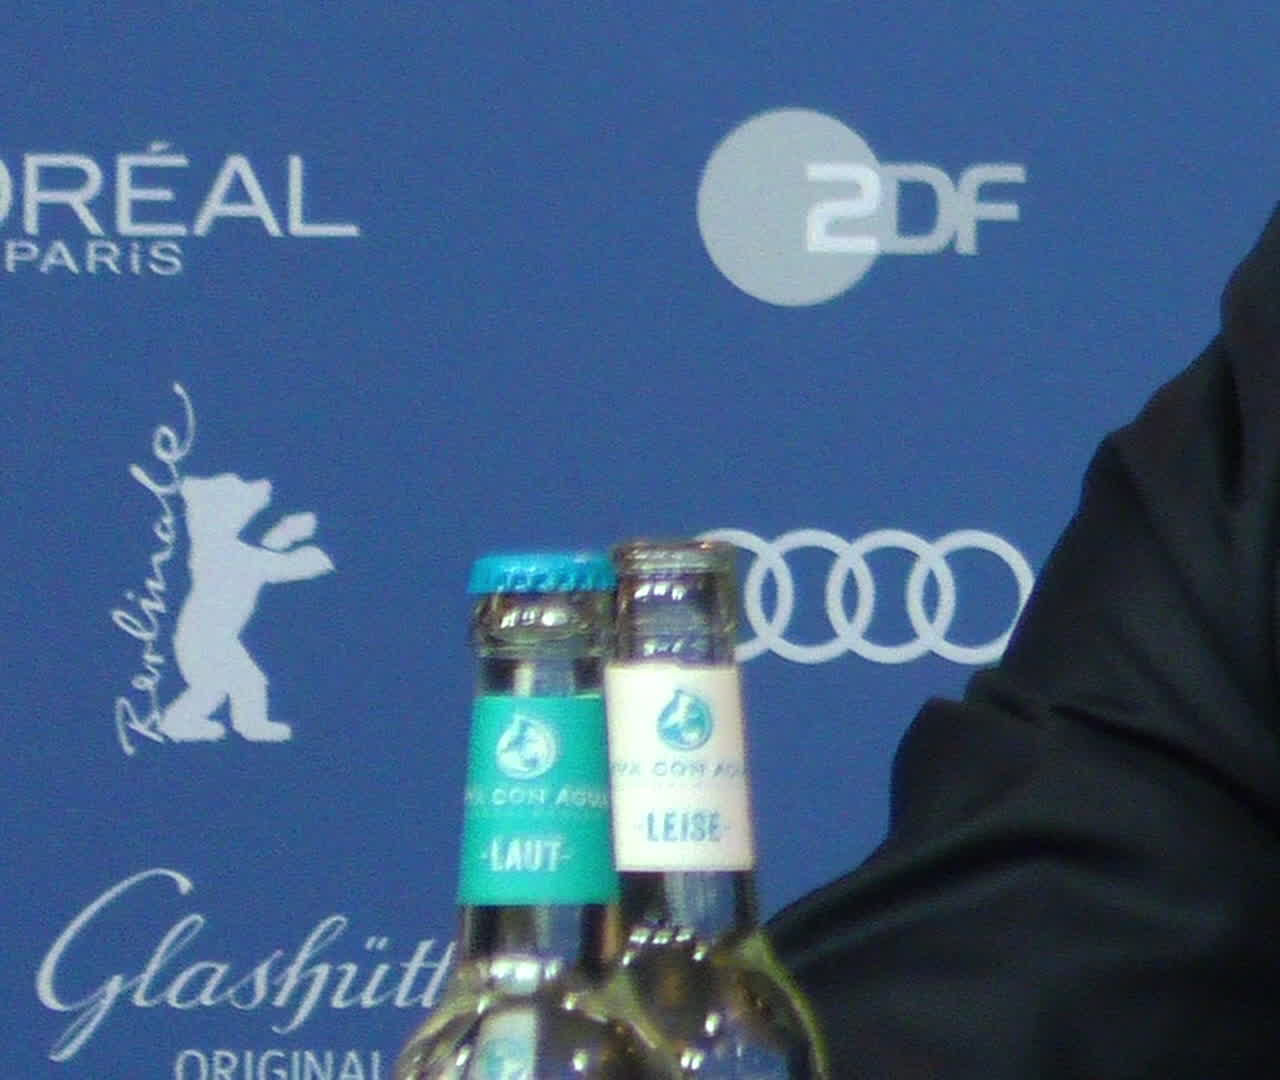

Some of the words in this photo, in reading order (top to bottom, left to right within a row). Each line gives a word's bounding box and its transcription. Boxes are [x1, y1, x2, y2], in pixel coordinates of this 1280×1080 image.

[0, 141, 360, 237] RÉAL
[113, 383, 197, 756] Berlinale
[490, 787, 546, 805] CON
[36, 868, 457, 1063] Glashütt
